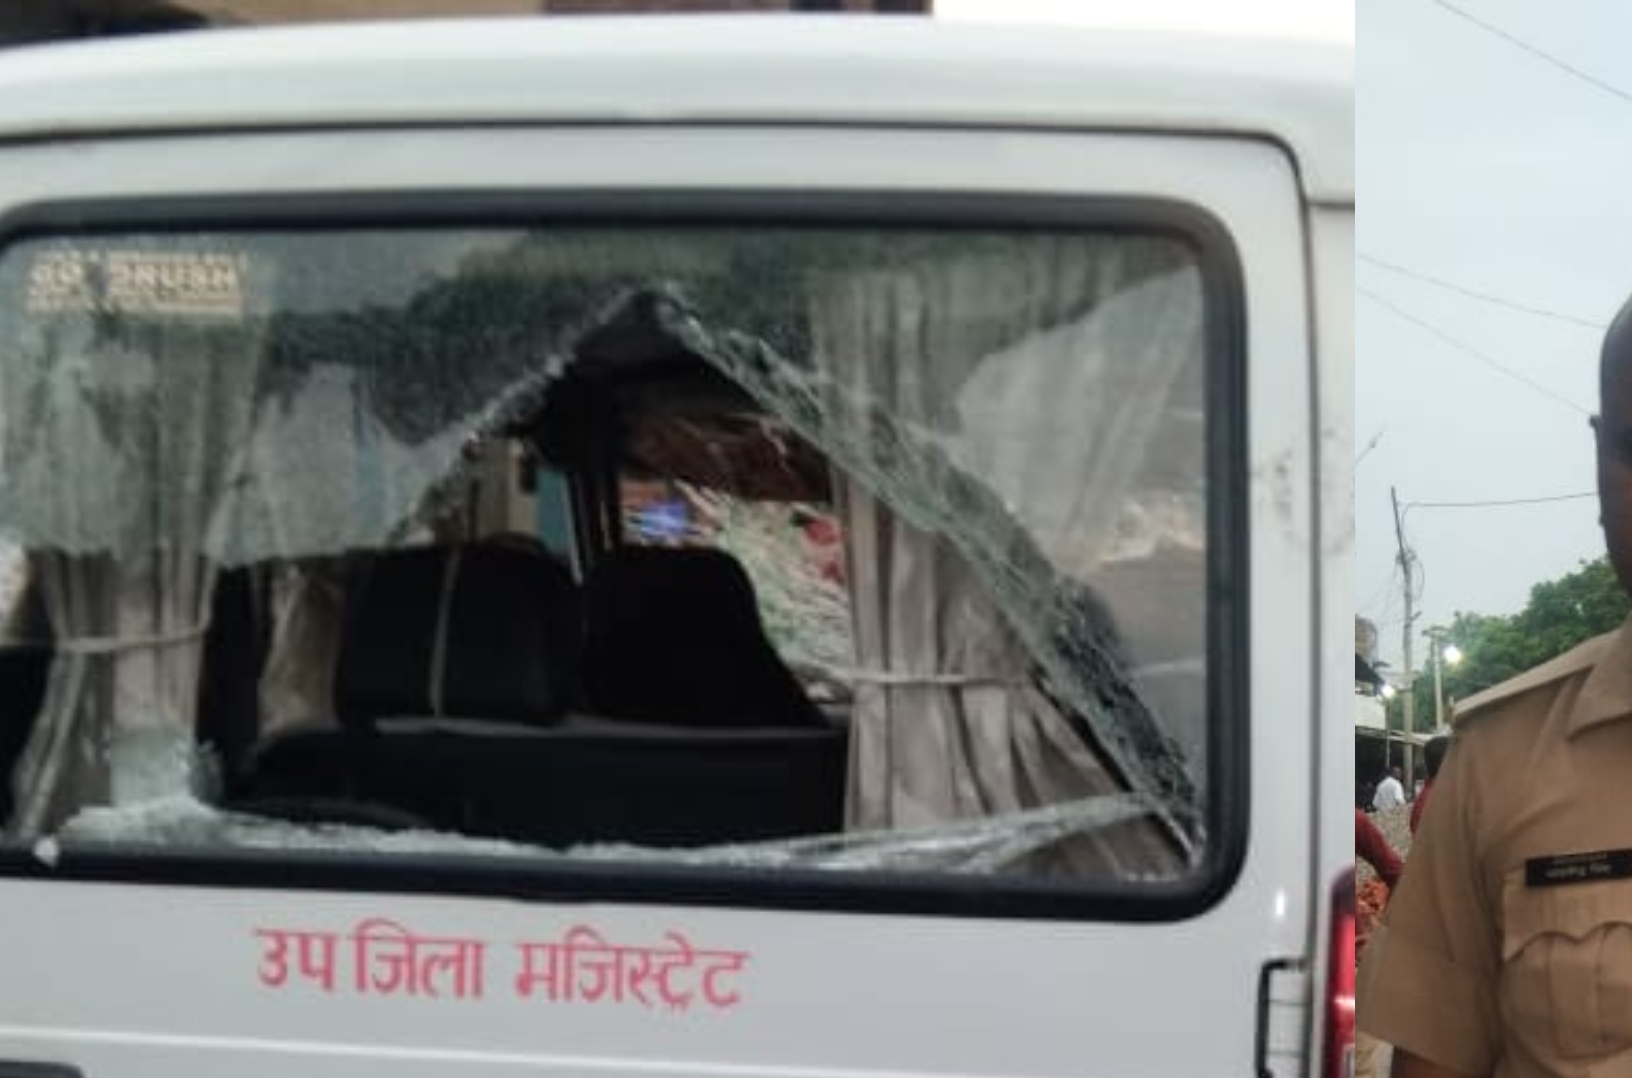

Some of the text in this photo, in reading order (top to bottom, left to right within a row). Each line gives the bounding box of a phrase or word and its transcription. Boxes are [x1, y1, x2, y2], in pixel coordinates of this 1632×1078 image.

[252, 917, 751, 1012] उप जिला मजिस्ट्रेट
